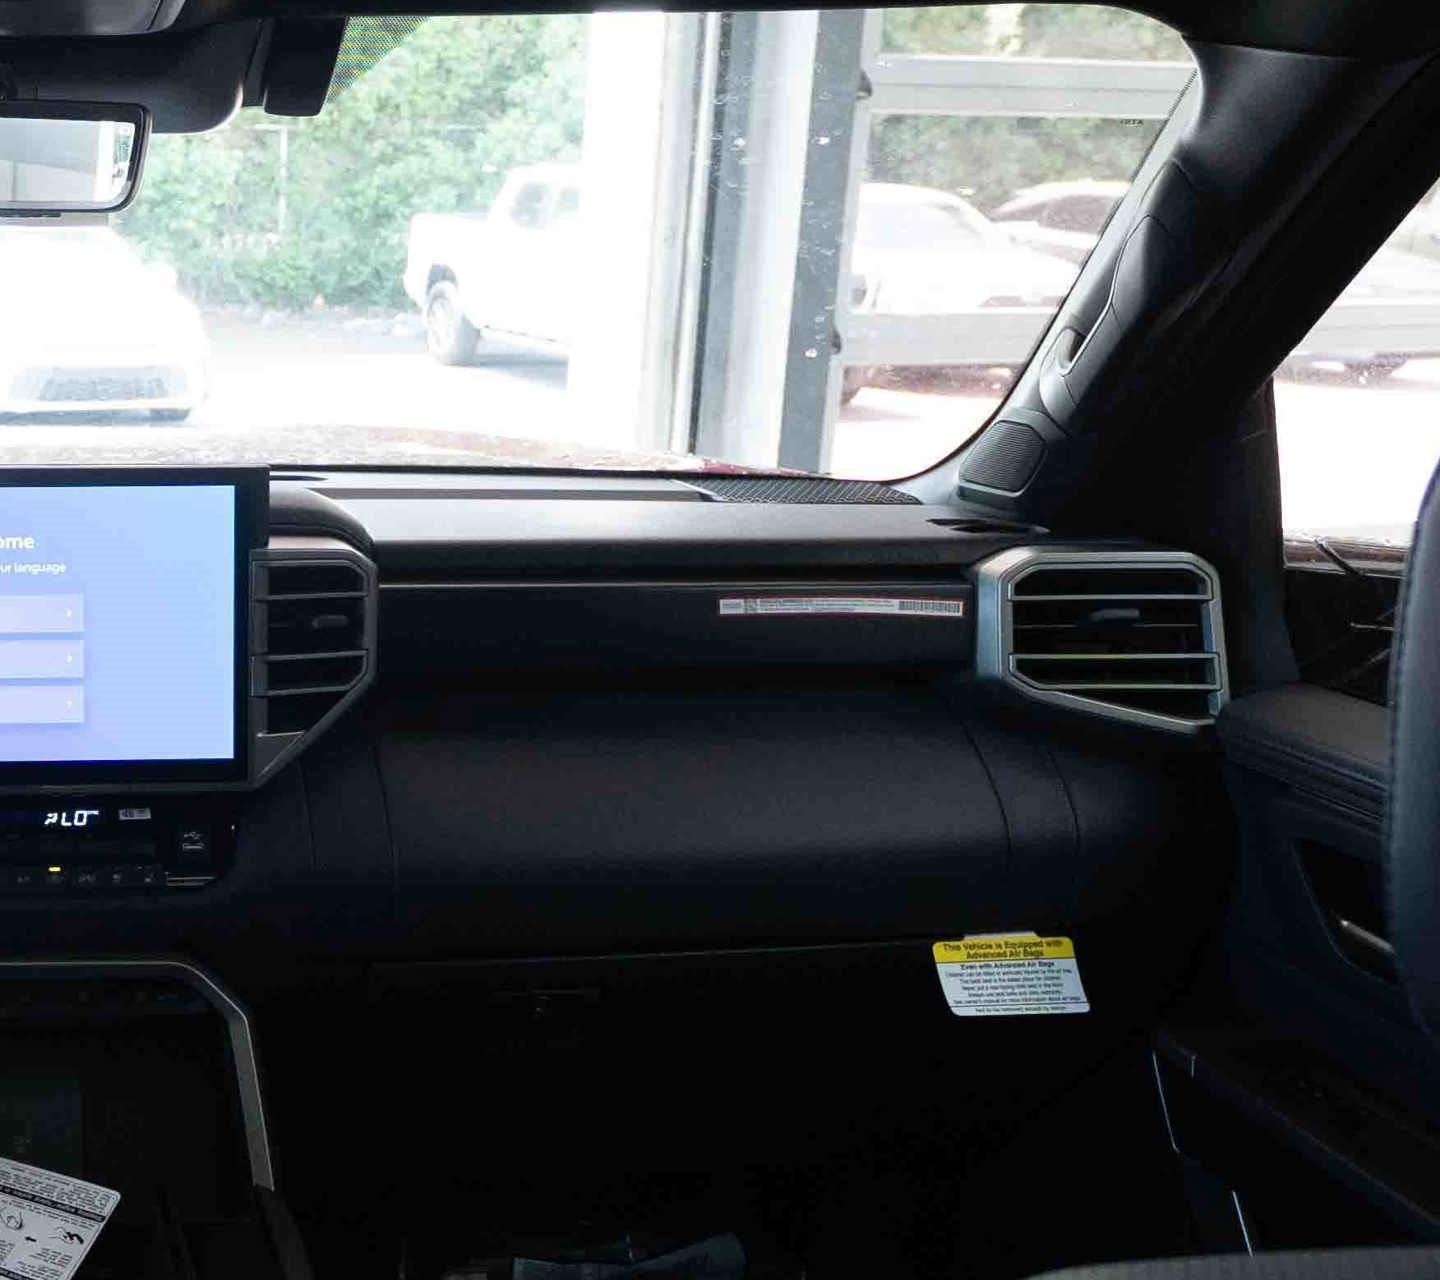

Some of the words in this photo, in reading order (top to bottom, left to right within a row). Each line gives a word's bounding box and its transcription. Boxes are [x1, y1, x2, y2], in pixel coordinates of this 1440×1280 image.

[14, 562, 66, 576] language
[61, 810, 88, 826] LO
[943, 942, 962, 952] This
[963, 941, 993, 951] Vehicle
[995, 941, 1002, 950] is
[1004, 940, 1043, 951] Equipped
[1044, 939, 1063, 949] with
[966, 950, 1007, 960] Advanced
[1008, 950, 1022, 958] Air
[1024, 949, 1044, 959] Bags
[993, 961, 1026, 970] Advanced
